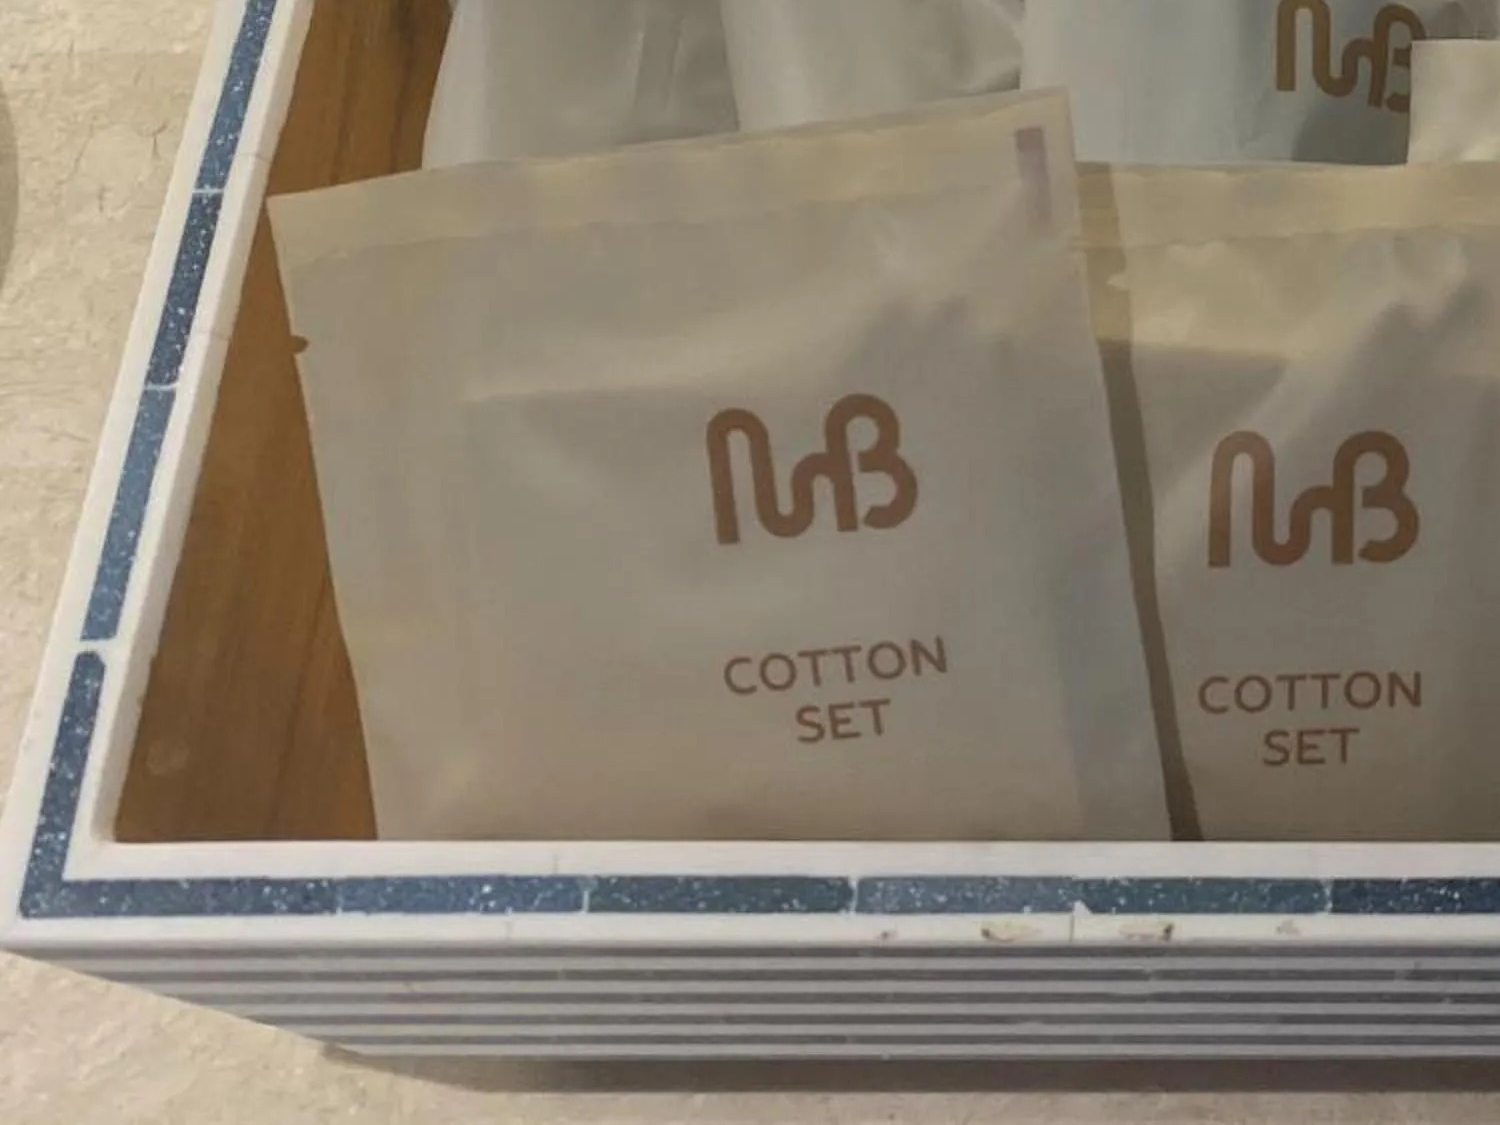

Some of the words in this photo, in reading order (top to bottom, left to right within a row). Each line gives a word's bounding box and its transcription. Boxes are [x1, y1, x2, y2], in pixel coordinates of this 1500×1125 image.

[723, 636, 947, 696] COTTON
[1199, 670, 1422, 715] COTTON
[795, 698, 891, 743] SET
[1262, 727, 1360, 767] SET
